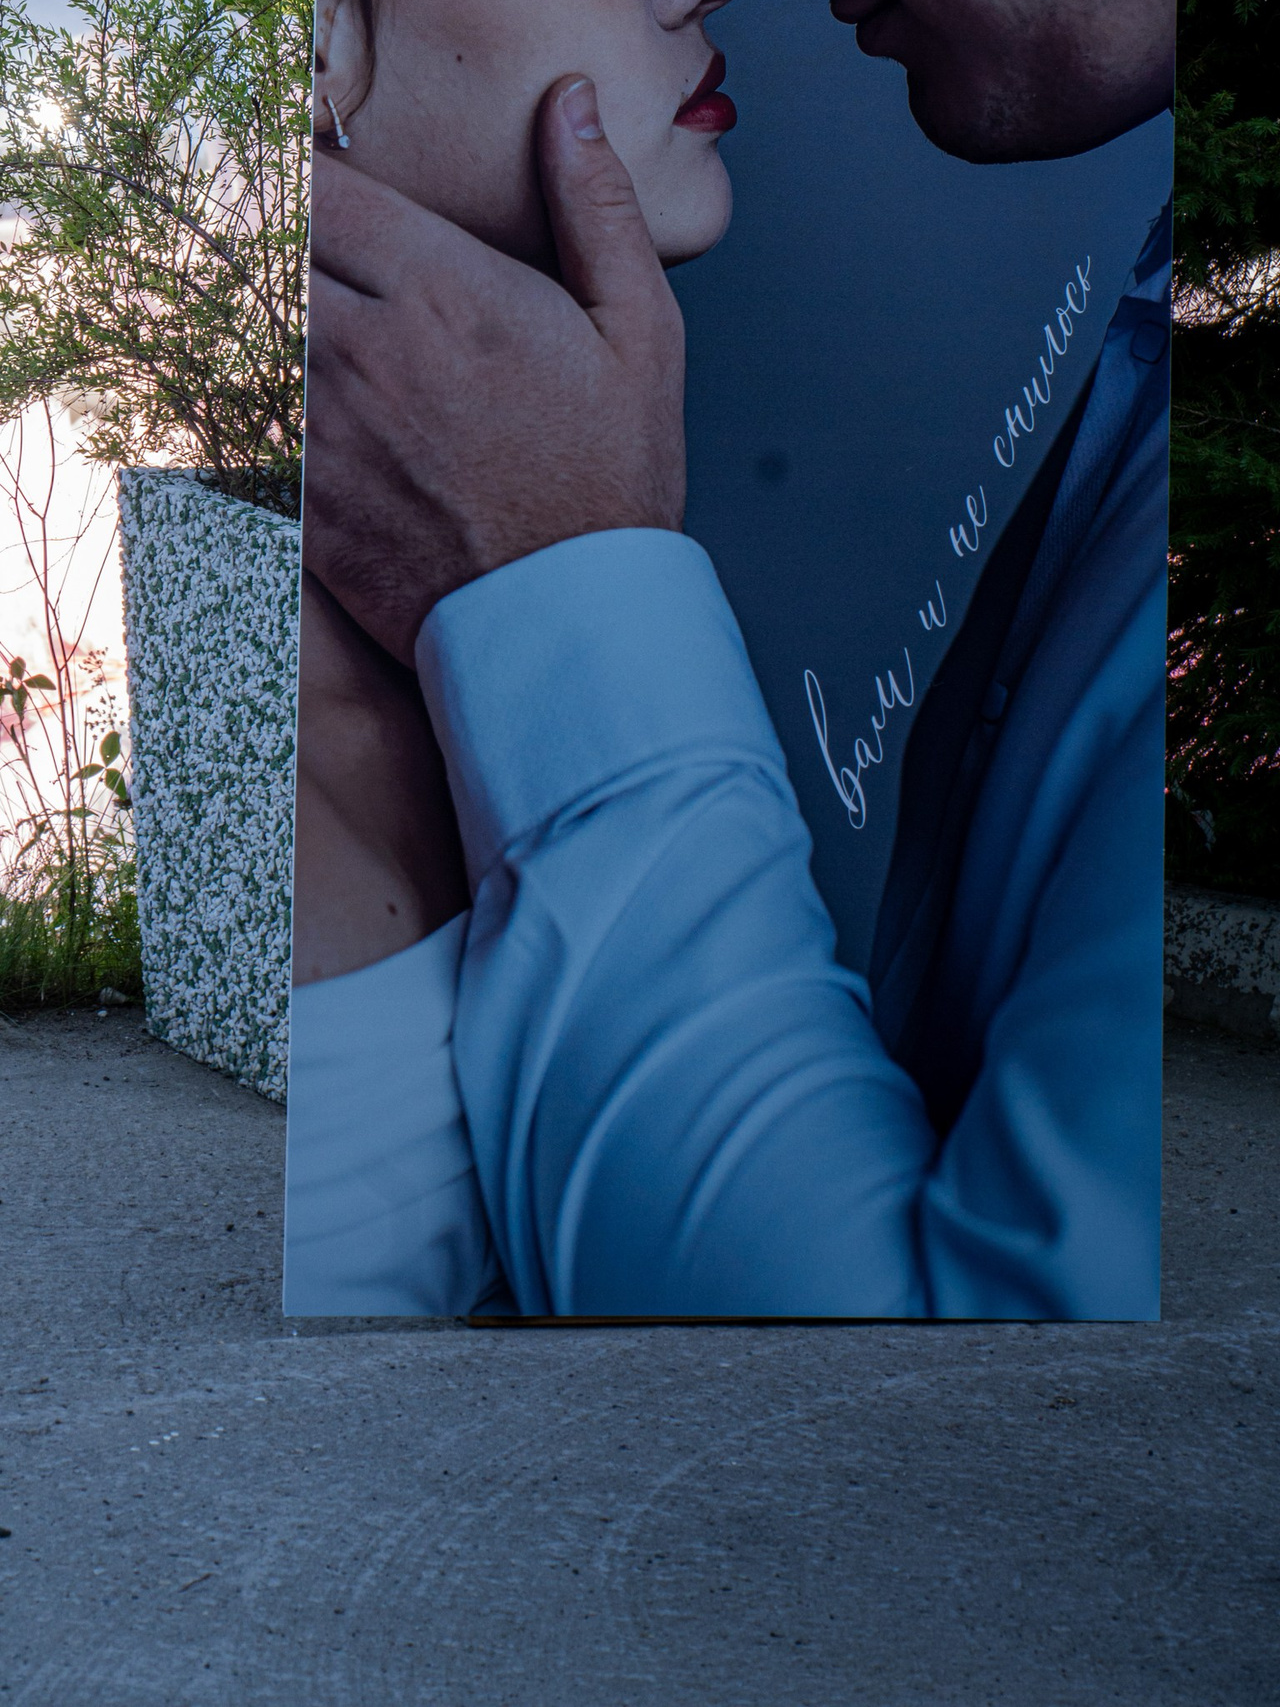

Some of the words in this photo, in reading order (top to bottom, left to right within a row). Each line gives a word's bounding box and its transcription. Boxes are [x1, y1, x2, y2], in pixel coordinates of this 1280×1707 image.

[919, 580, 948, 630] и
[949, 484, 989, 558] не
[993, 255, 1092, 469] снилось
